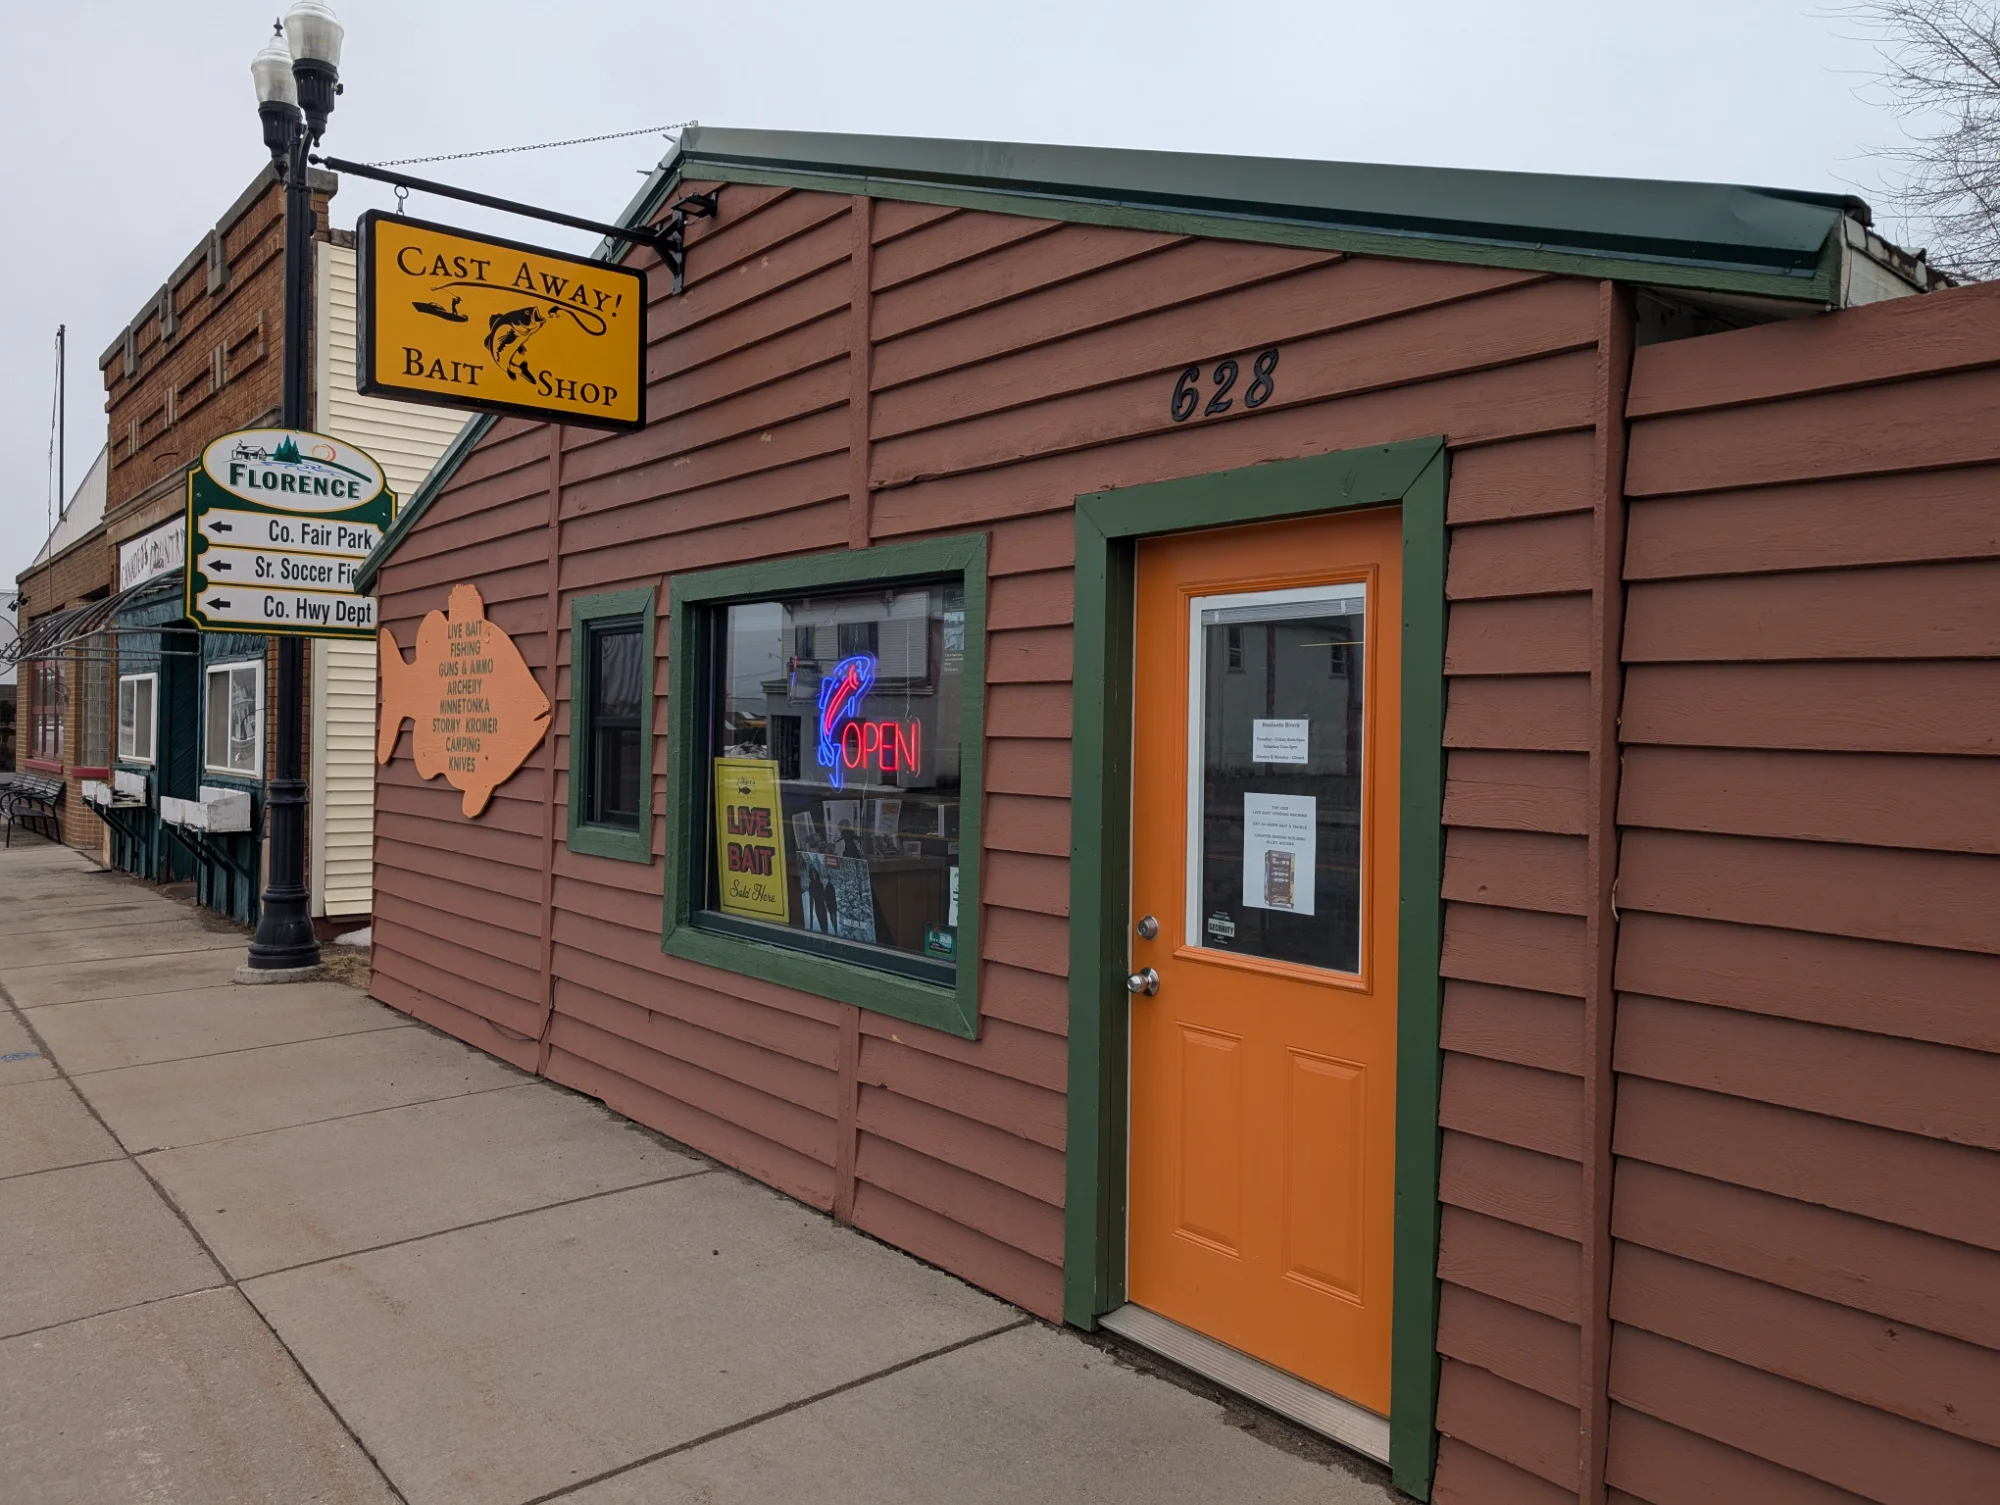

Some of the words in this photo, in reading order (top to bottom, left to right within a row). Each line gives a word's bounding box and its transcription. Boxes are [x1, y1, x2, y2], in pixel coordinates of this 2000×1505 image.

[397, 246, 490, 281] CAST
[512, 261, 622, 318] AWAY!
[402, 346, 484, 386] BAIT
[538, 370, 618, 406] SHOP
[1171, 348, 1279, 422] 628
[229, 462, 361, 500] FLORENCE
[269, 519, 294, 543] Co.
[301, 523, 332, 546] Fair
[337, 526, 372, 550] Park
[255, 555, 275, 578] Sr.
[281, 557, 333, 583] Soccer
[263, 595, 289, 618] Co.
[296, 598, 330, 625] Hwy
[336, 600, 371, 627] Dept
[448, 622, 462, 639] LIVE
[465, 620, 482, 637] BAIT
[450, 641, 481, 658] FISHING
[438, 662, 458, 677] GUNS
[461, 660, 468, 675] &
[470, 658, 494, 674] AMMO
[447, 679, 482, 696] ARCHERY
[440, 699, 490, 714] MINNETONKA
[432, 718, 460, 733] STORMY
[465, 717, 498, 734] KROMER
[446, 736, 481, 753] CAMPING
[842, 721, 916, 772] OPEN
[448, 756, 476, 773] KNIVES
[727, 805, 773, 838] LIVE
[727, 842, 776, 877] BAIT
[729, 878, 750, 899] Sold
[752, 883, 776, 903] Here
[1208, 922, 1233, 934] SECURITY
